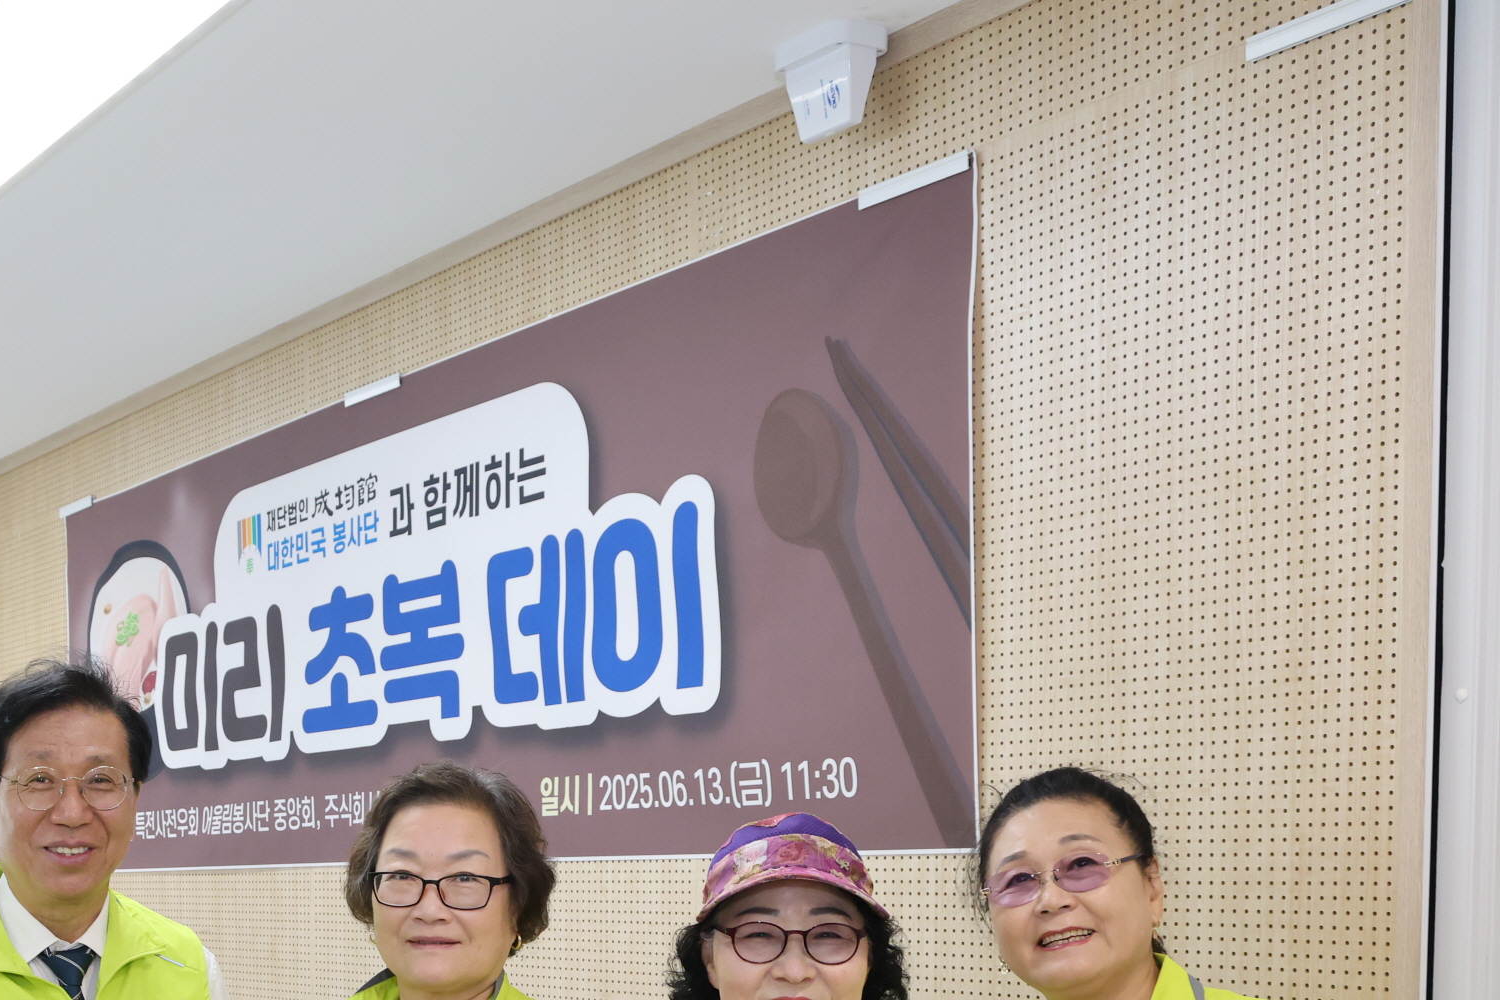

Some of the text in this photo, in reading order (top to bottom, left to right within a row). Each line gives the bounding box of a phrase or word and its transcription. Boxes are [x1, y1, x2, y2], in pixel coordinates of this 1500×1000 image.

[266, 472, 378, 532] 재단법인 成均館
[389, 447, 547, 538] 과 함께하는
[267, 509, 379, 571] 대한민국 봉사단
[164, 501, 704, 752] 미리 초복 데이
[540, 756, 858, 817] 일시 2025.06.13.(금) 11:30
[135, 806, 199, 840] 특전사전우회
[202, 800, 270, 835] 어울림봉사단
[273, 795, 321, 831] 중앙회,
